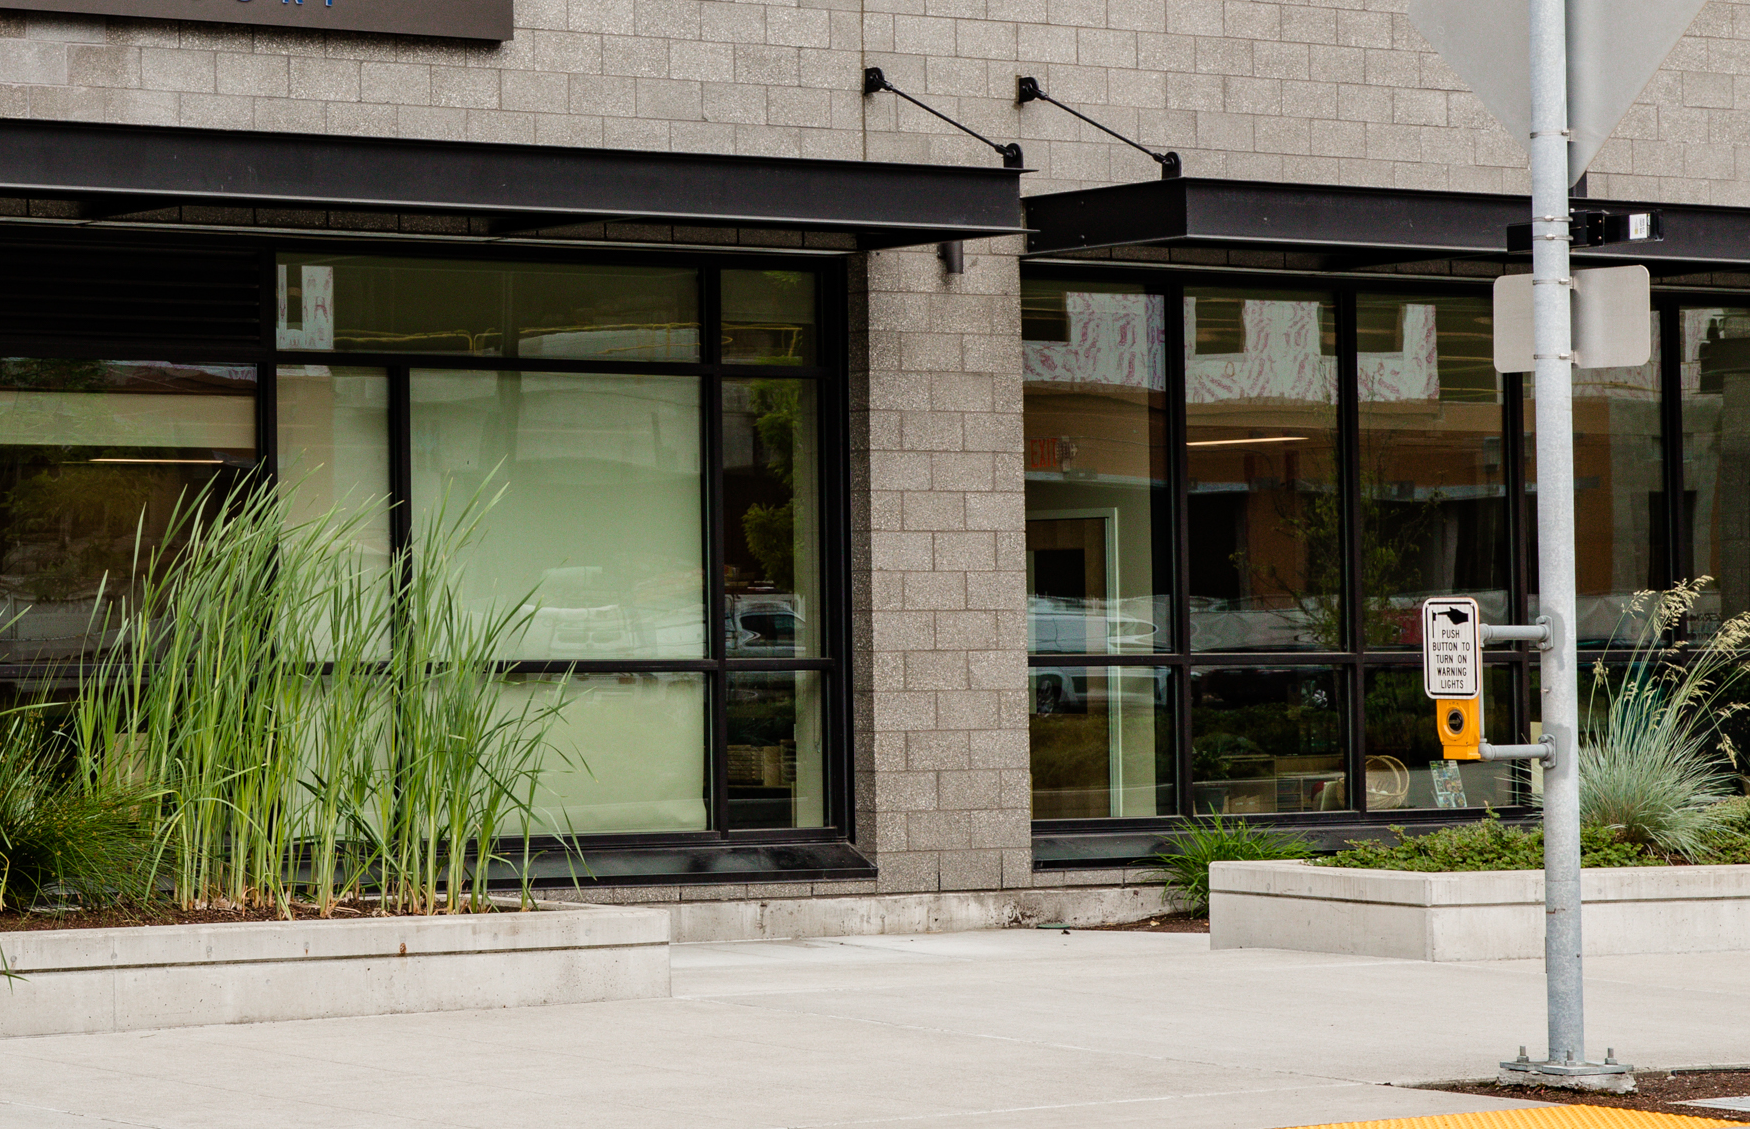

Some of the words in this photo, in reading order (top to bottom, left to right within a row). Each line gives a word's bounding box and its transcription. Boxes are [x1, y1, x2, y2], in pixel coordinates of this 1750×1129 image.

[1030, 433, 1058, 468] EXIT
[1441, 629, 1460, 639] PUSH
[1432, 641, 1458, 651] BUTTON
[1462, 641, 1471, 651] TO
[1436, 654, 1454, 664] TURN
[1457, 654, 1468, 664] ON
[1436, 667, 1467, 677] WARNING
[1441, 679, 1464, 689] LIGHTS
